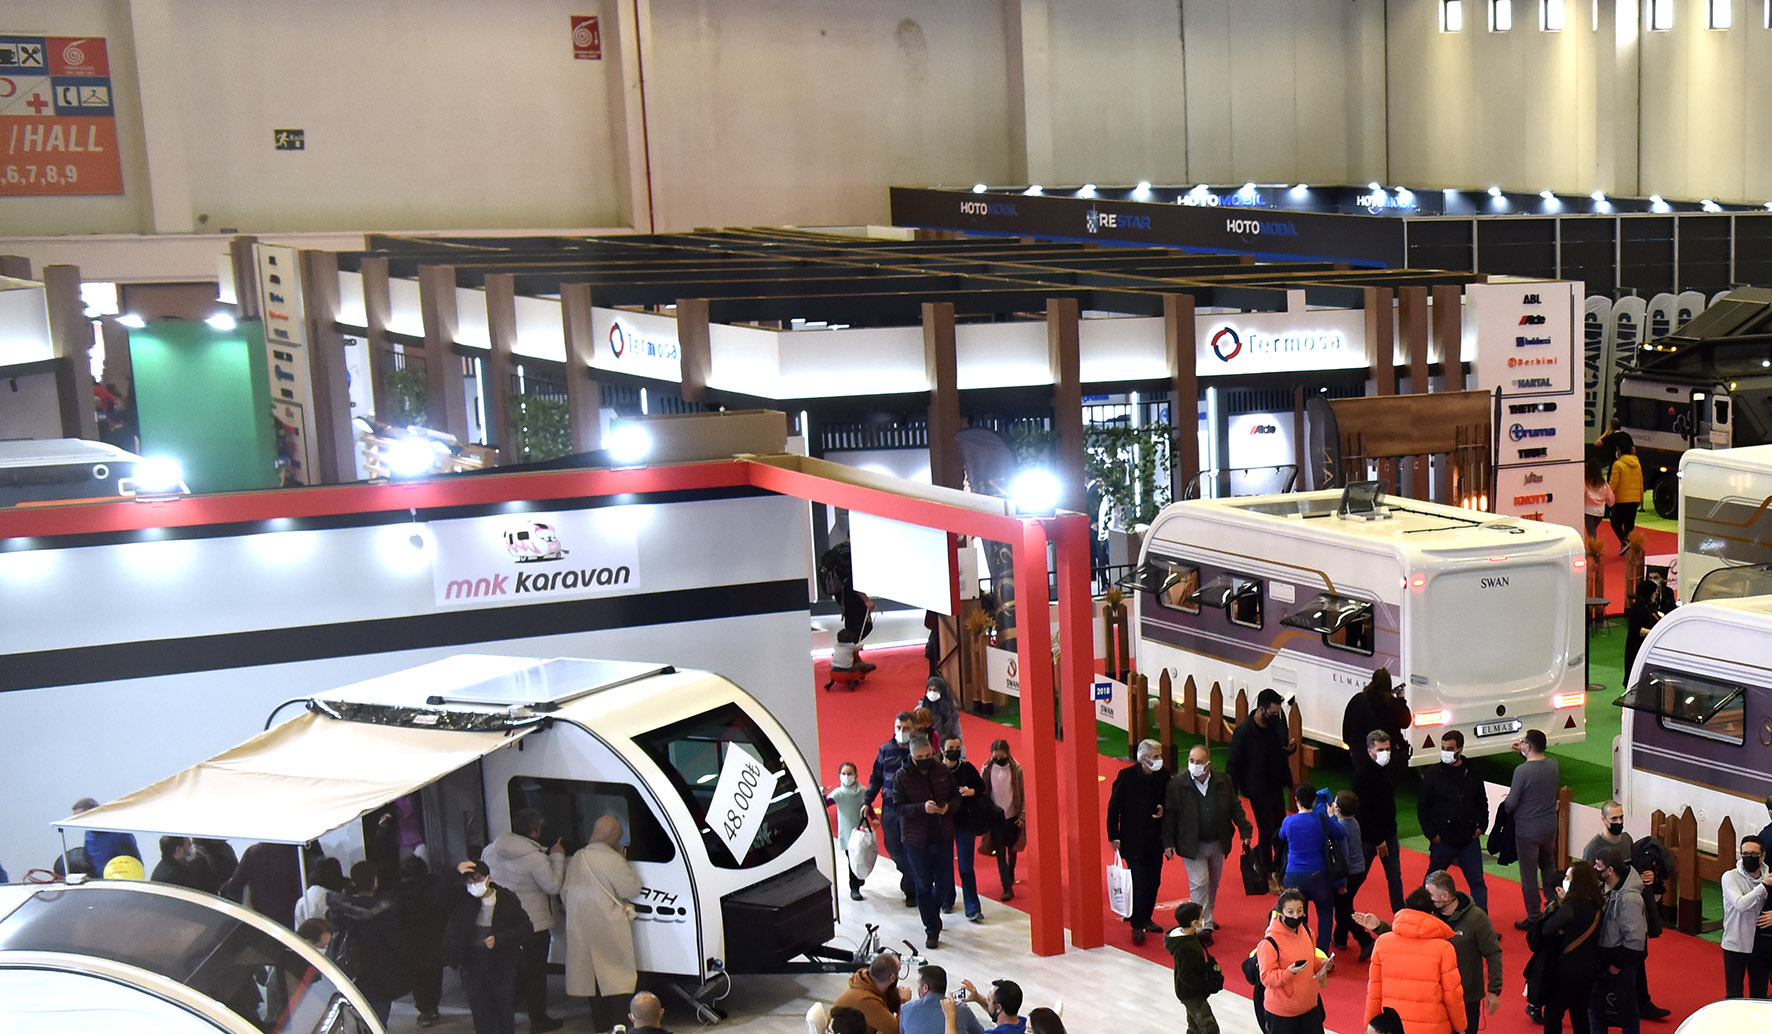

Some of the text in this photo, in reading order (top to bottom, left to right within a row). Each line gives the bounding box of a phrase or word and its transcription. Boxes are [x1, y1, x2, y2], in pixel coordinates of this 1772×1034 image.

[1099, 213, 1151, 231] RESTAR
[1245, 333, 1341, 353] Termosa
[1511, 423, 1556, 440] truma
[445, 565, 631, 600] mnk karavan
[1480, 576, 1510, 589] SWAN
[1481, 722, 1514, 735] ELMAS
[639, 886, 679, 906] ATH
